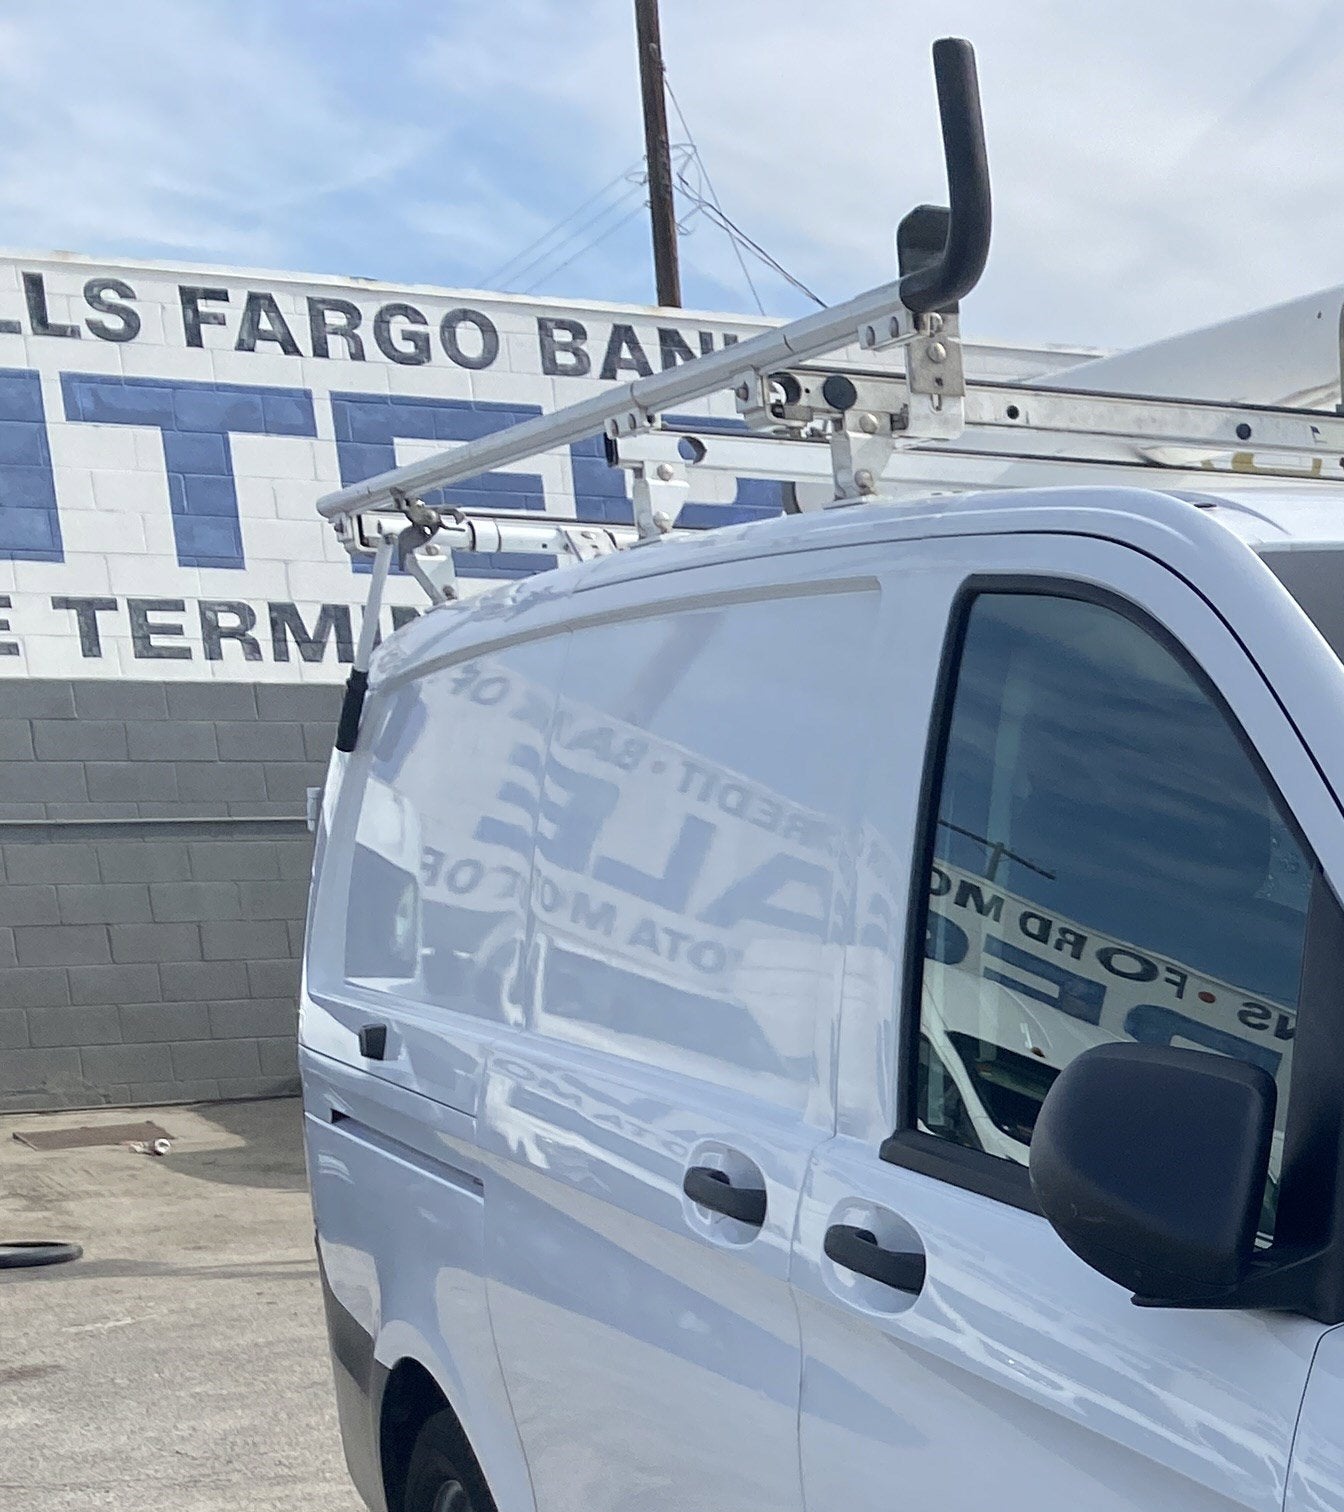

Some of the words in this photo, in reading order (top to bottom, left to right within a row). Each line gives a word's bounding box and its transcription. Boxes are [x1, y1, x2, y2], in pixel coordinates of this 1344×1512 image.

[178, 284, 500, 370] FARGO
[536, 316, 739, 379] BAN
[51, 596, 421, 663] TERM
